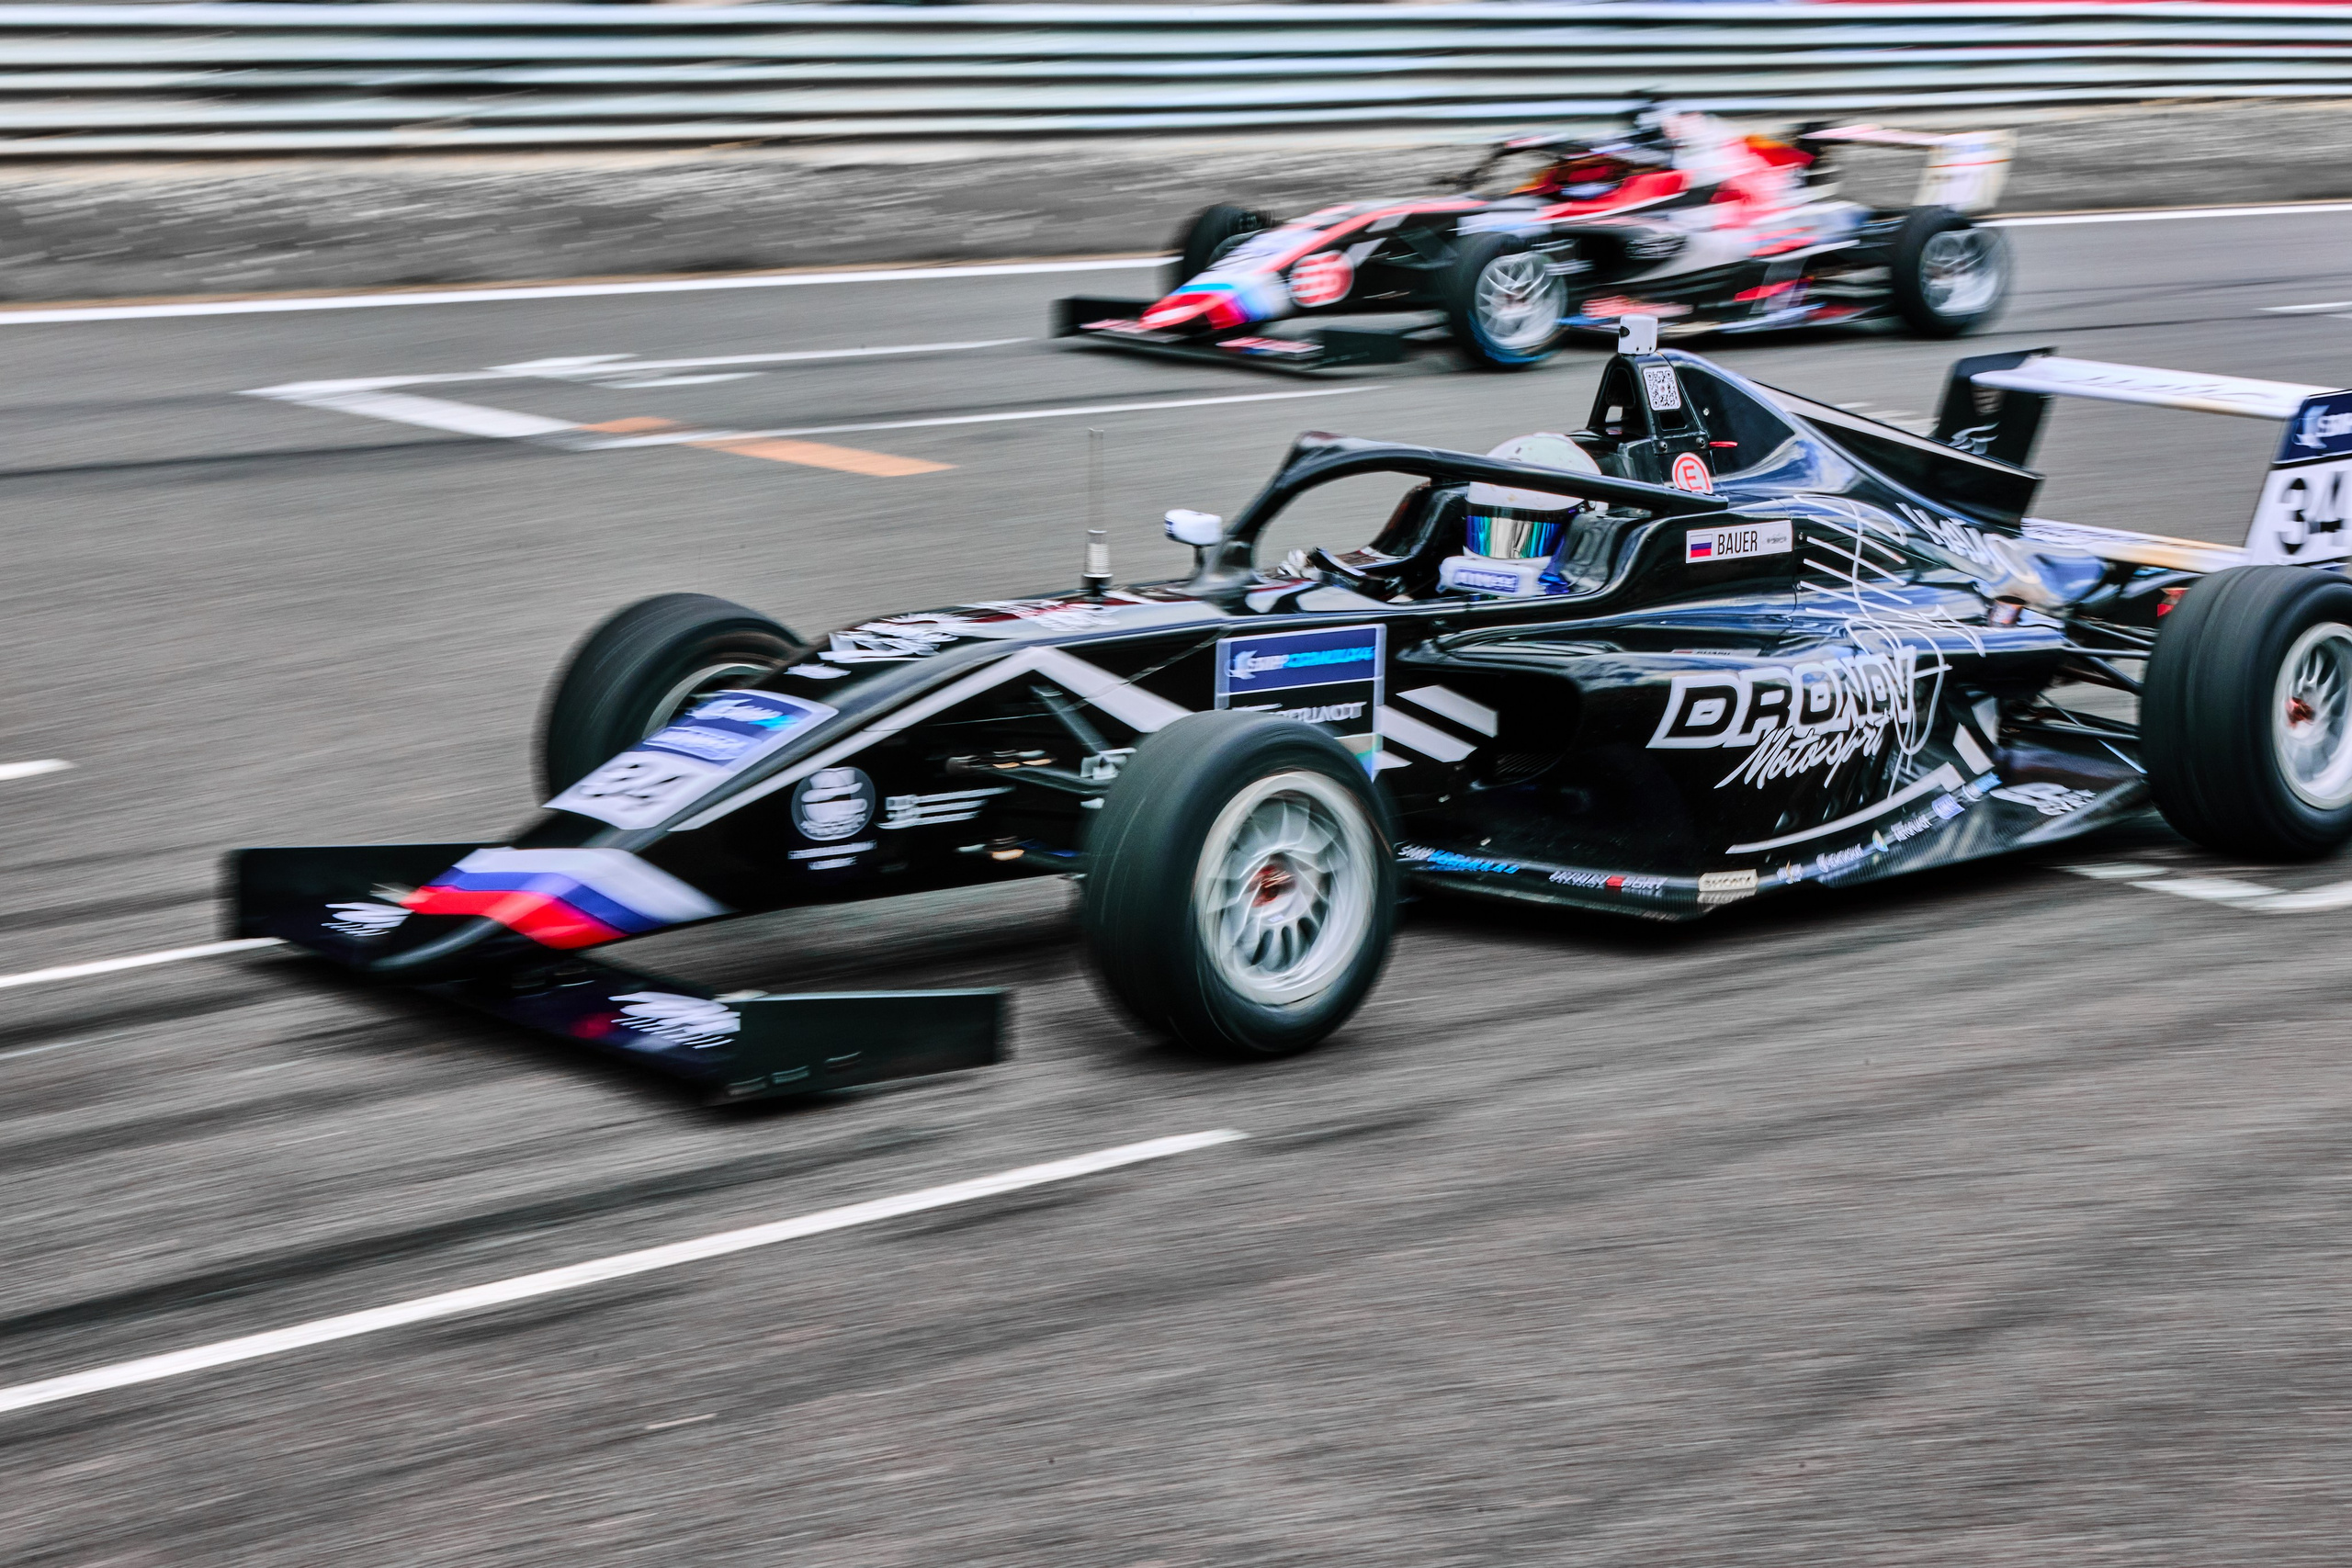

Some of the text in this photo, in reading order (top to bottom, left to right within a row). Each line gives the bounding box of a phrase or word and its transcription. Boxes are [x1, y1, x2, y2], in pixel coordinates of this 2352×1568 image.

[1682, 465, 1703, 491] E
[2276, 472, 2352, 555] 34
[1716, 530, 1758, 556] BAUER
